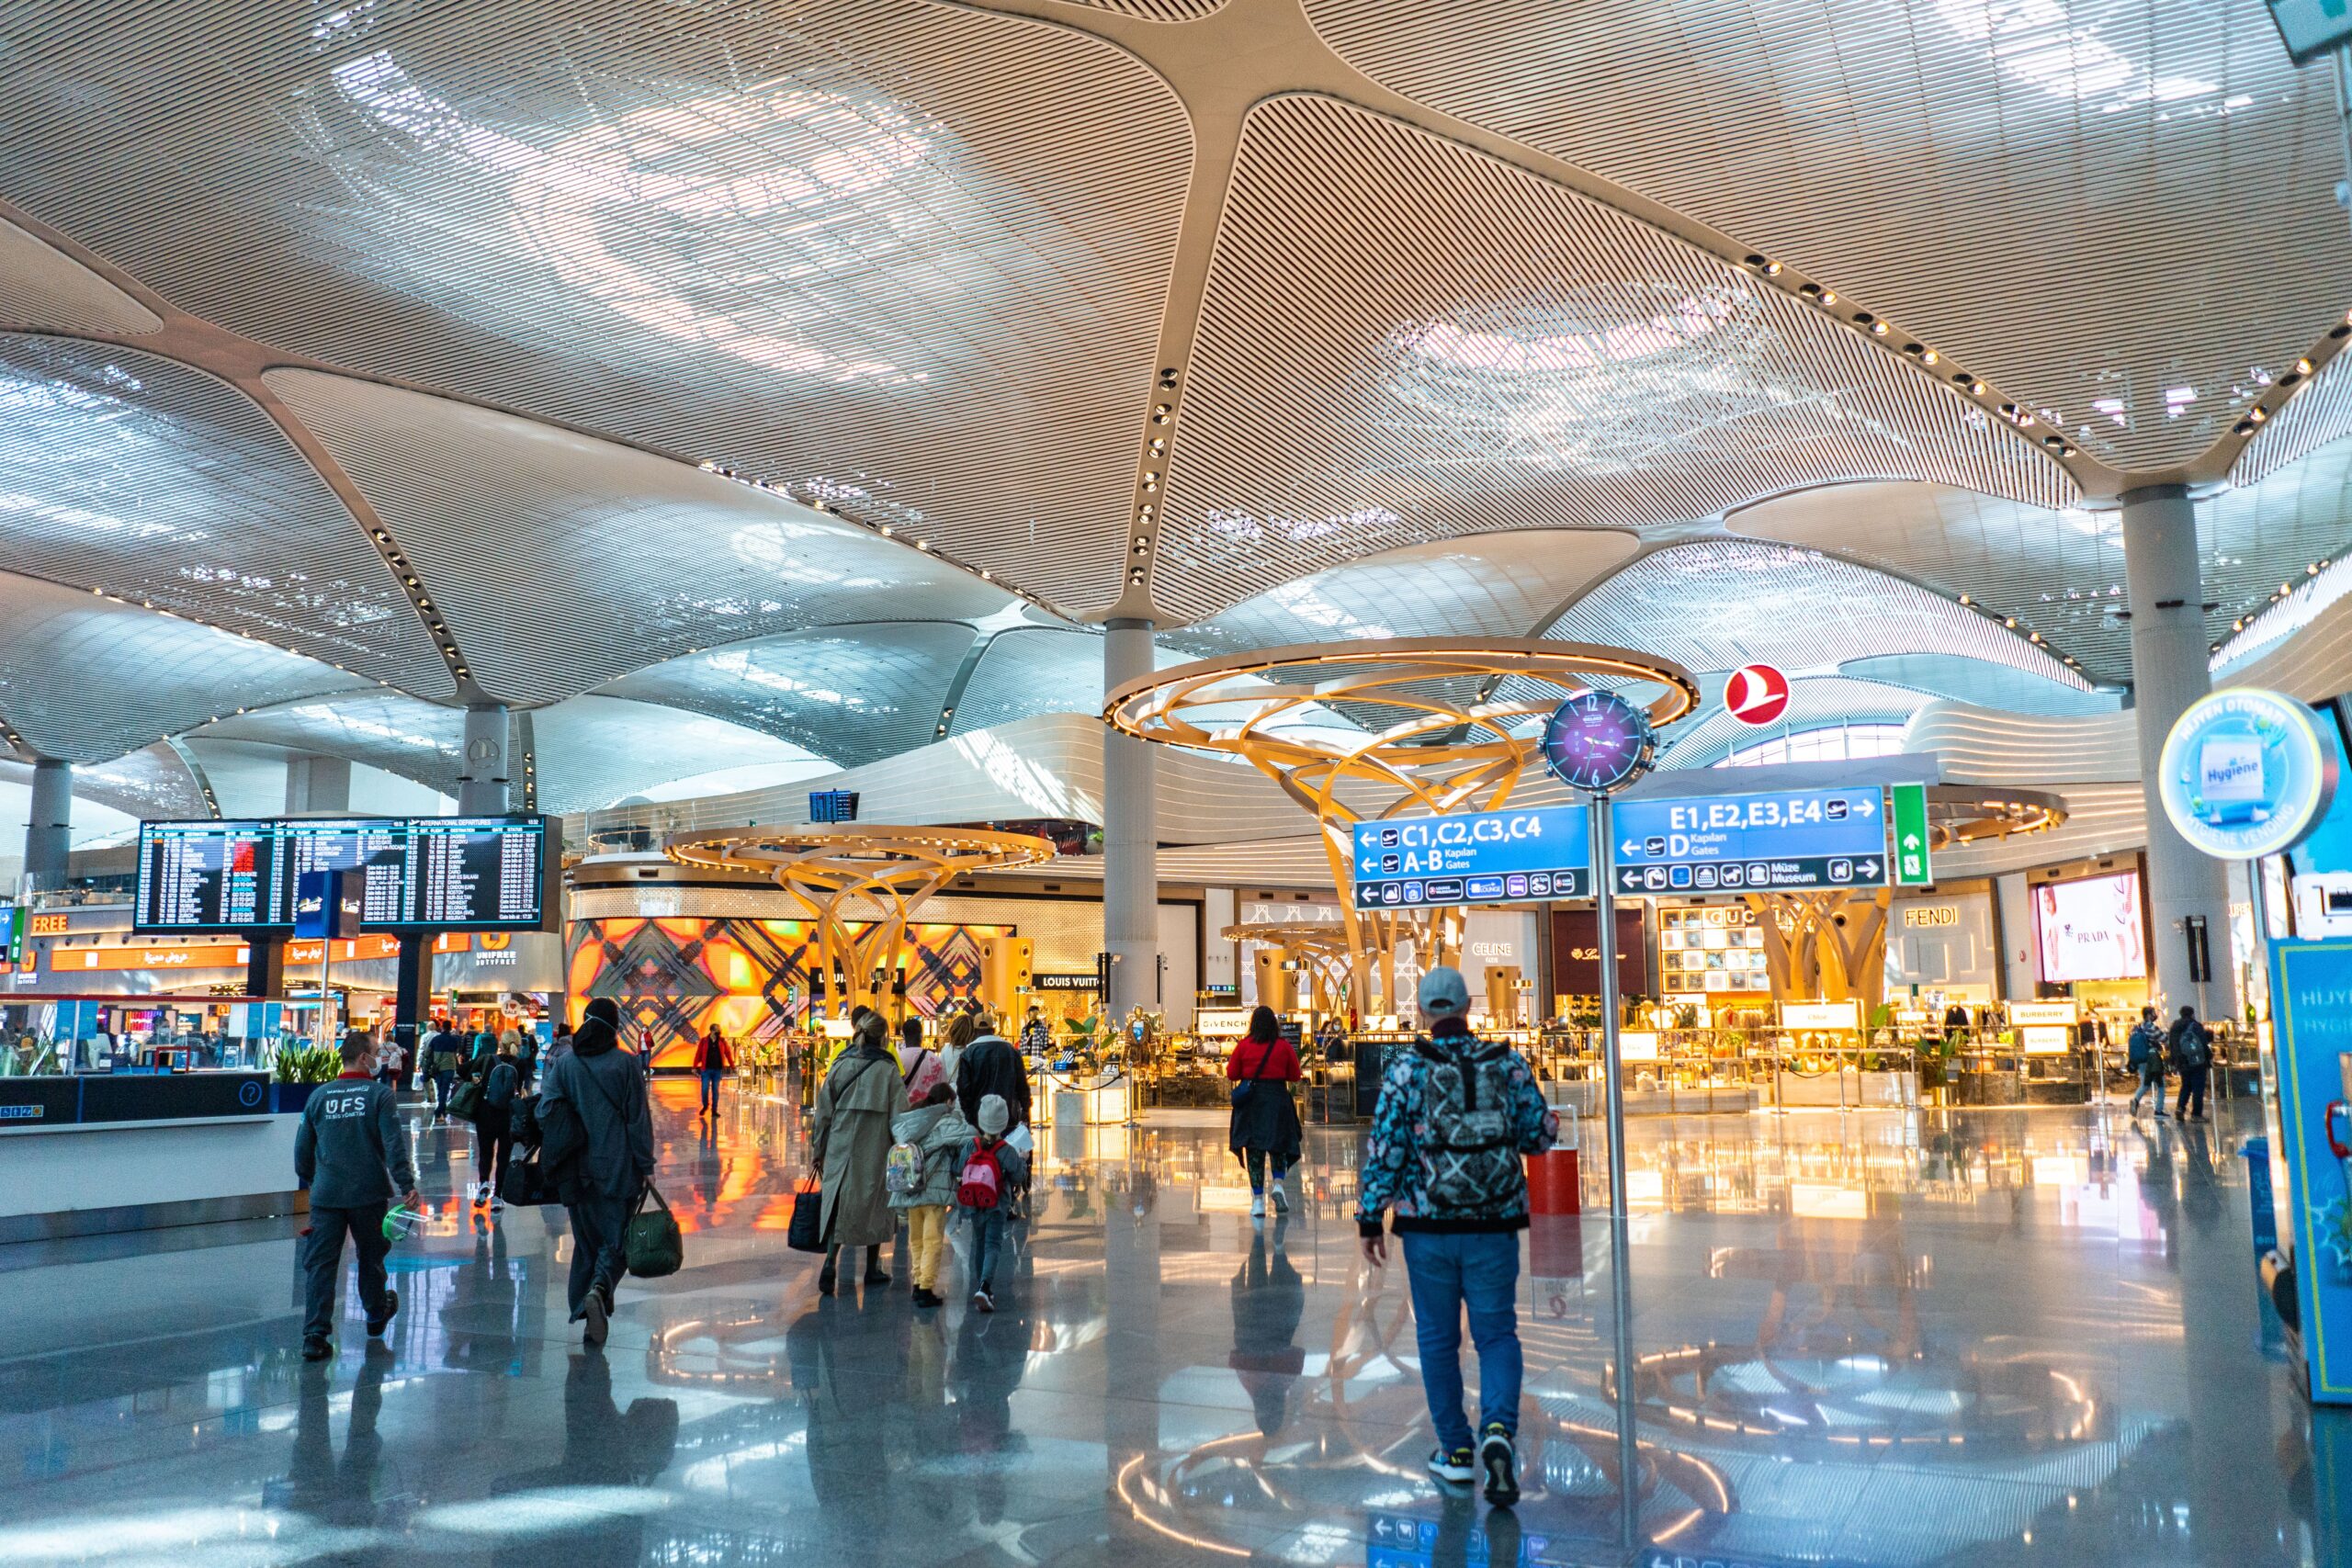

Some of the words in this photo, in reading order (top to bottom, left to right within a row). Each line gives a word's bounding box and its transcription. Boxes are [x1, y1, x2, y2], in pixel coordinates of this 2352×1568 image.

[1587, 695, 1598, 711] 12
[1591, 769, 1599, 785] 6
[2208, 761, 2258, 782] Hygiene
[1670, 799, 1822, 831] E1,E2,E3,E4
[1402, 817, 1542, 848] C1,C2,C3,C4
[2242, 804, 2295, 845] VENDING
[1670, 834, 1690, 857] D
[1691, 845, 1719, 856] Gates
[1404, 850, 1442, 873] A-B
[1445, 860, 1470, 870] Gates
[1771, 863, 1800, 874] Müze
[1771, 872, 1816, 884] Museum
[32, 915, 68, 932] FREE
[1905, 907, 1957, 928] FENDI
[2077, 931, 2109, 944] PRADA
[1472, 942, 1512, 956] CELINE
[819, 973, 846, 983] LUI
[1043, 977, 1070, 987] LOUIS
[1071, 977, 1099, 987] VUITT
